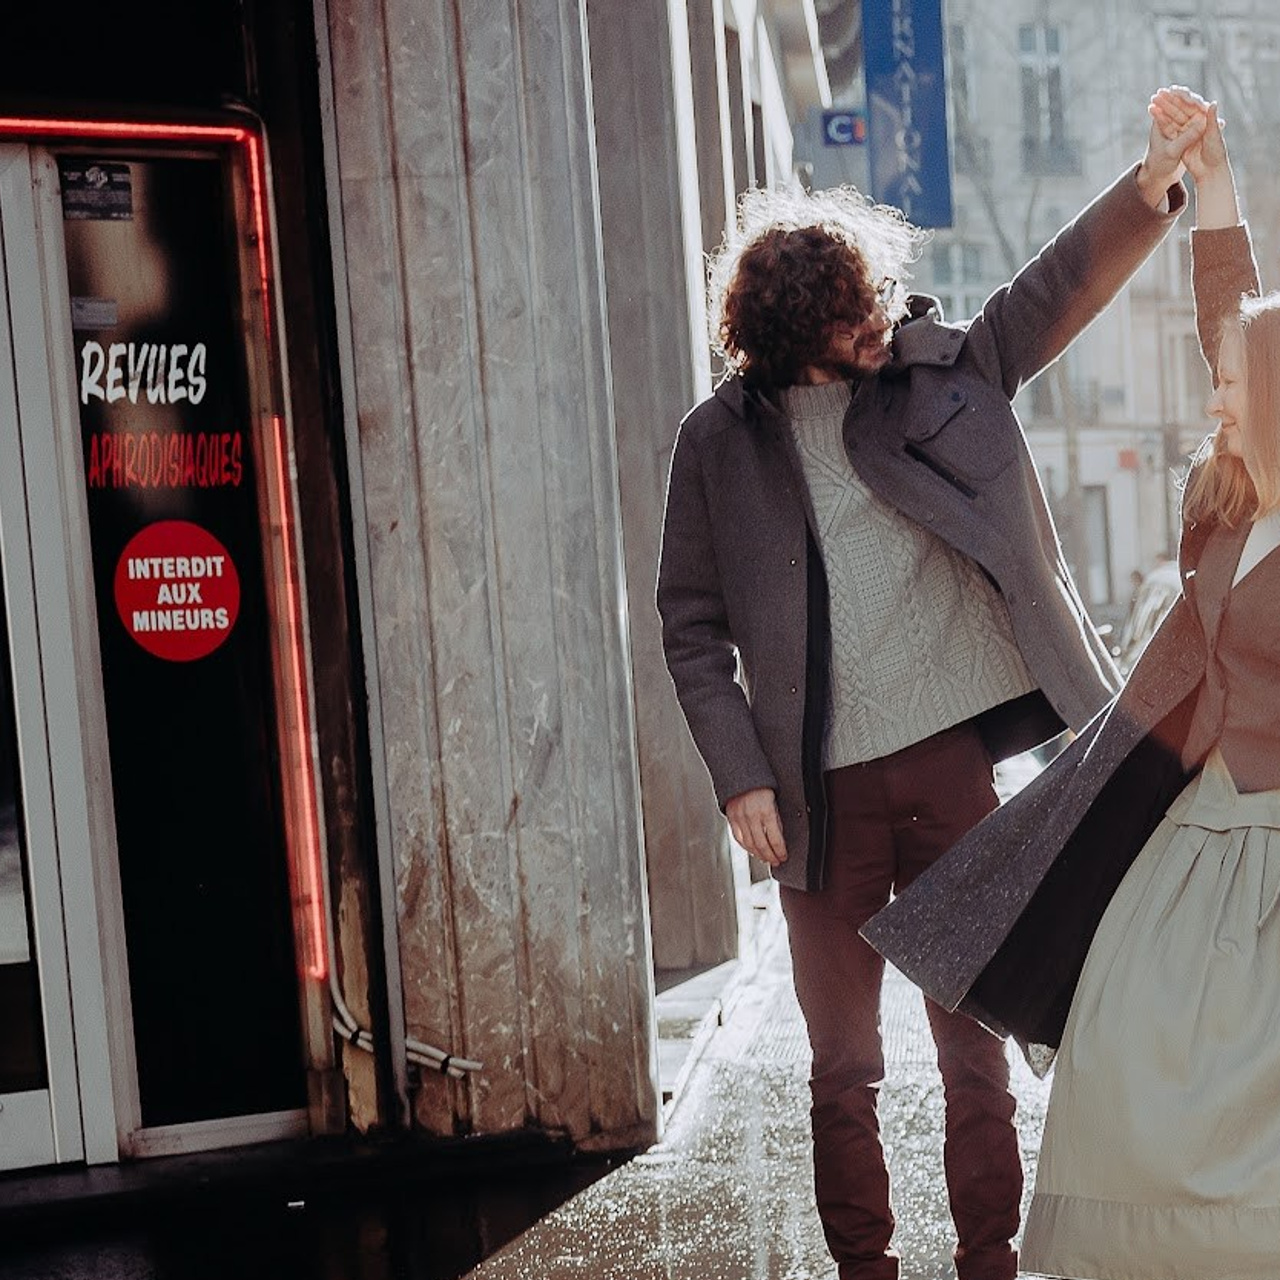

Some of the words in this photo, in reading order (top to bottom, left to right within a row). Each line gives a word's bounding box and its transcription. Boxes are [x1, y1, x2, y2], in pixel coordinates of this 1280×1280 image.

[81, 340, 207, 405] REVUES
[88, 431, 243, 489] APHRODISIAQUES
[128, 555, 225, 579] INTERDIT
[157, 582, 203, 605] AUX
[132, 607, 229, 632] MINEURS
